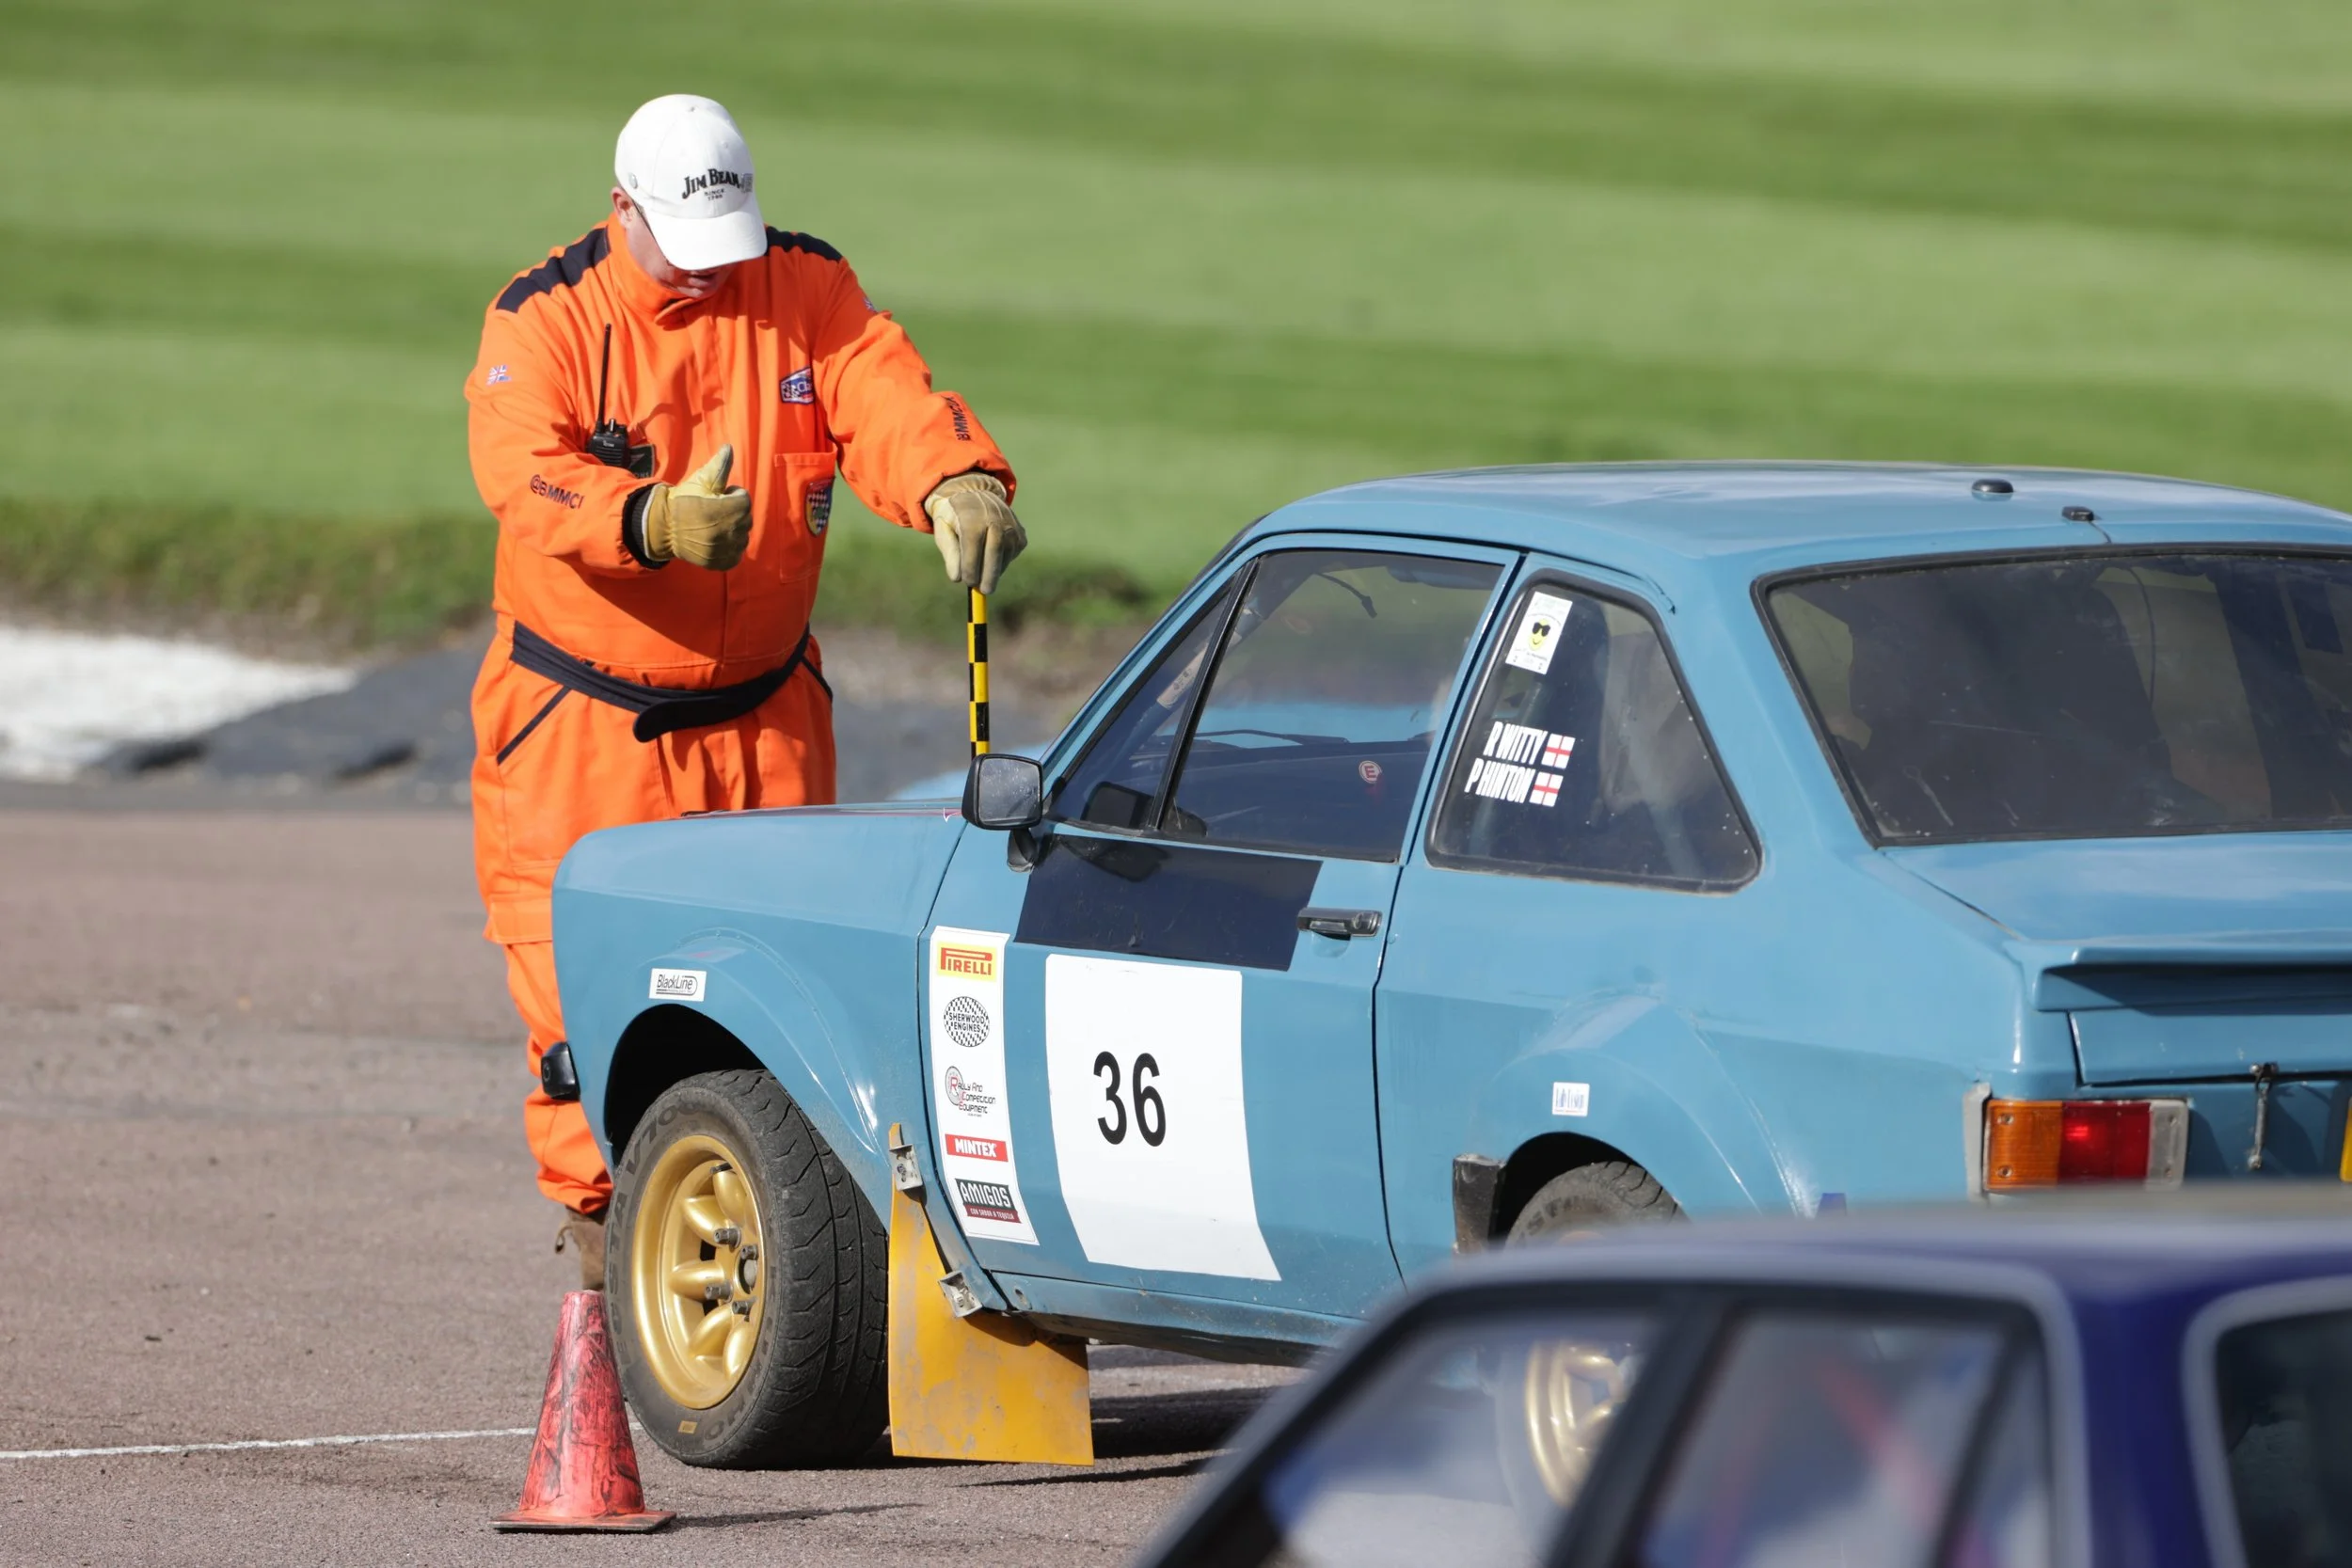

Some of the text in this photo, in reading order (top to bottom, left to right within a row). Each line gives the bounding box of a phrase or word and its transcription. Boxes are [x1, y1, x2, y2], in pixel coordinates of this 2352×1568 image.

[682, 174, 707, 199] JIM
[1495, 723, 1549, 766] WITTY
[941, 947, 993, 976] PIRELLI
[949, 1012, 985, 1024] SHERWOOD
[953, 1022, 981, 1033] ENGINES
[1093, 1051, 1167, 1148] 36
[954, 1138, 997, 1158] MINTEX
[960, 1181, 1012, 1208] AMIGOS
